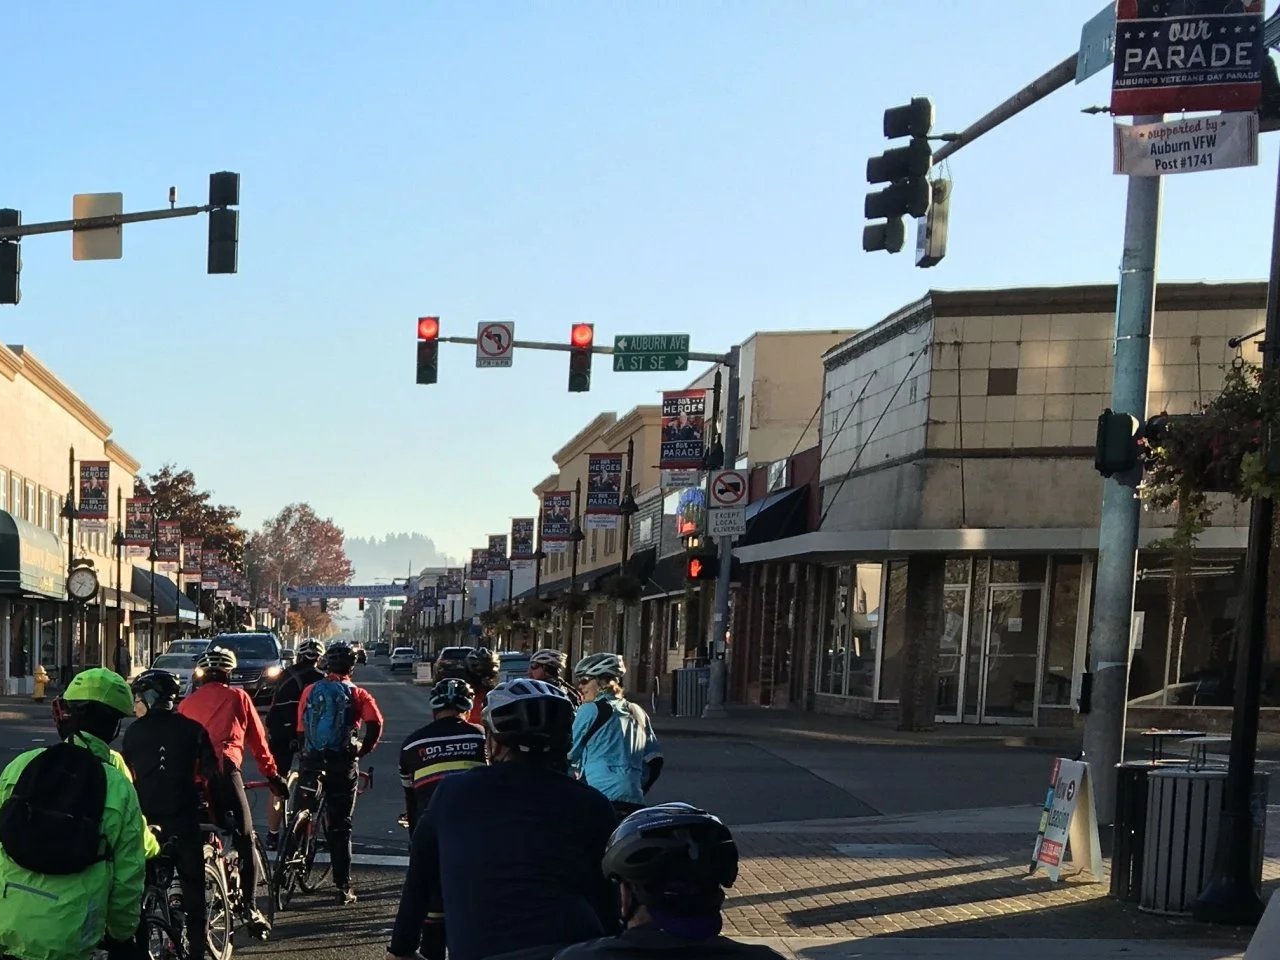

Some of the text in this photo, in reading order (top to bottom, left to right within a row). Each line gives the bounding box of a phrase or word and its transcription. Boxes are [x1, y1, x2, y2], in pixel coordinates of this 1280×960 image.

[1168, 20, 1212, 42] our
[1123, 42, 1253, 72] PARADE
[1114, 71, 1260, 87] AUBURN'S VETERANS DAY PARADE
[1147, 119, 1218, 141] supported by
[1150, 134, 1217, 156] Auburn VFW
[1155, 153, 1213, 171] Post #1741
[630, 335, 687, 350] AUBURN AVE
[616, 355, 666, 370] A ST SE
[663, 403, 704, 414] HEROES
[663, 448, 701, 458] PARADE
[445, 742, 478, 751] STOP
